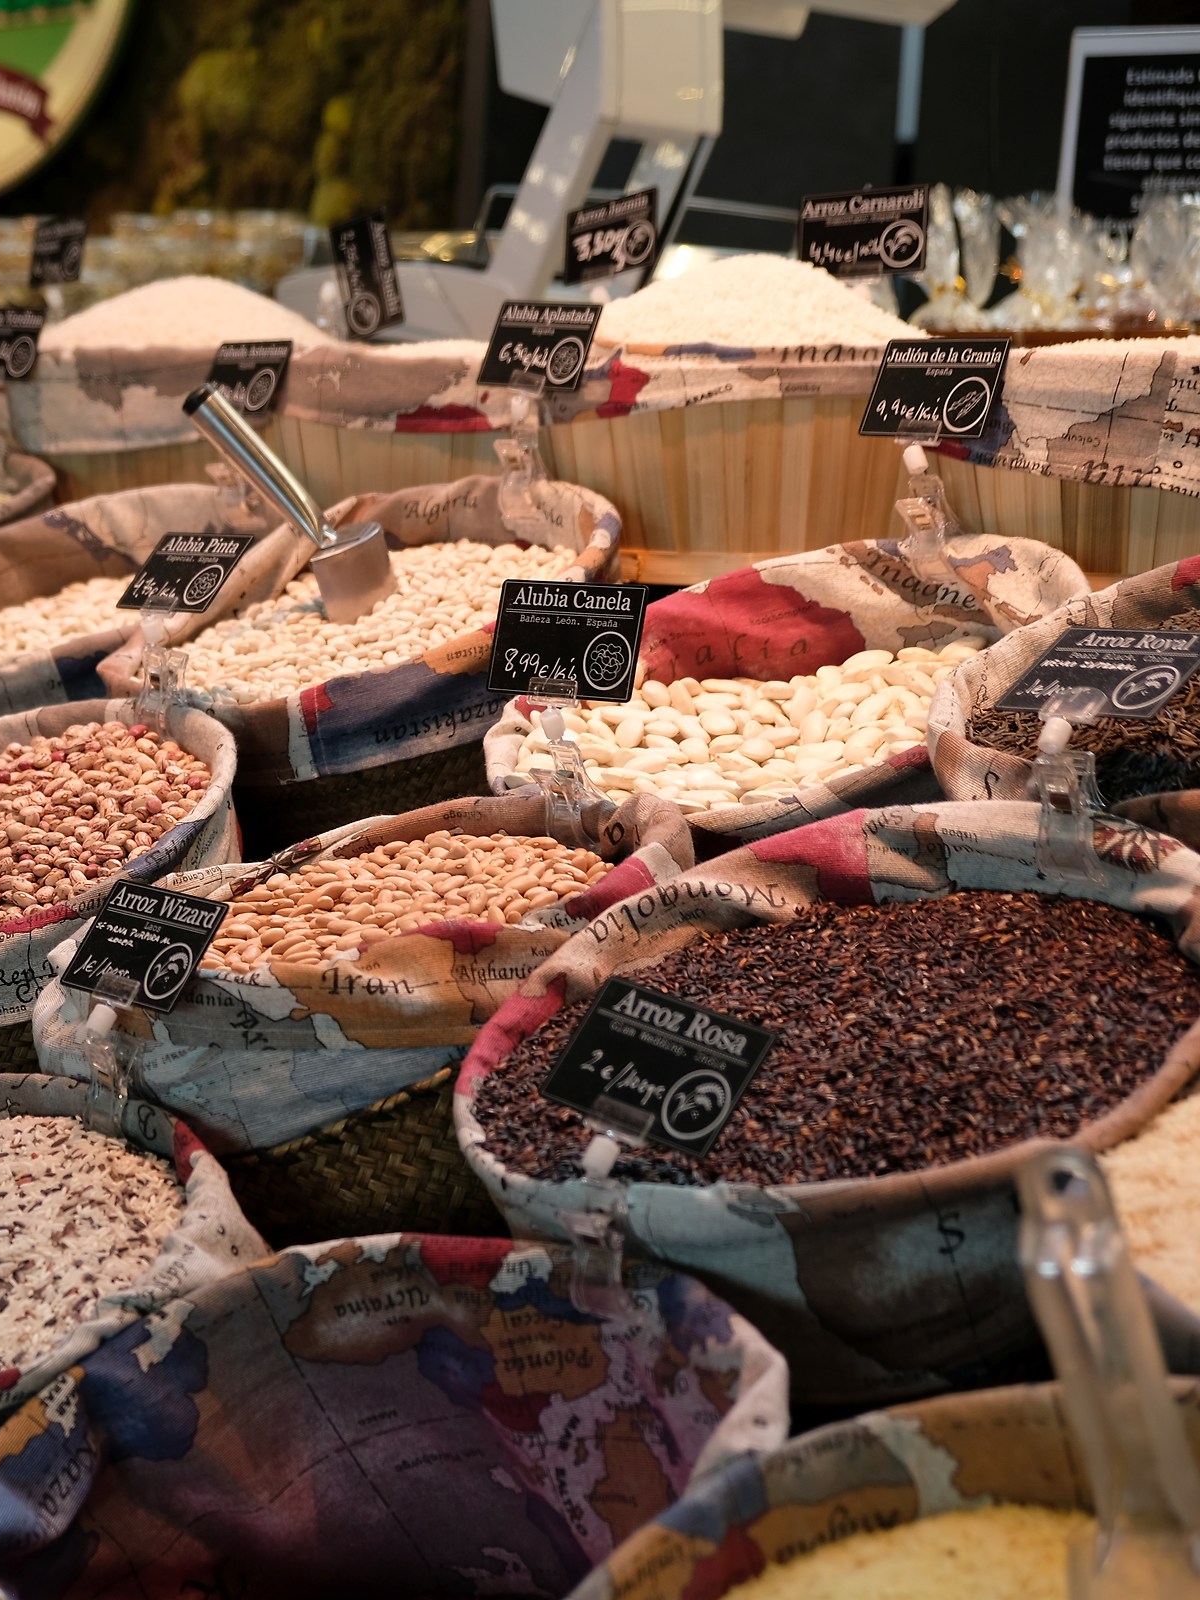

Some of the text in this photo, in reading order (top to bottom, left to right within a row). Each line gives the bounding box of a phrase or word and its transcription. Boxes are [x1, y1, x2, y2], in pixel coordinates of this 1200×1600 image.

[801, 189, 924, 219] Arroz Carnaroli
[503, 305, 595, 327] Alubia Aplastada
[887, 347, 1002, 365] Judión de la Granja
[925, 367, 953, 378] España
[161, 536, 240, 554] Alubia Pinta
[513, 586, 631, 612] Alubia Canela
[519, 614, 618, 628] Bañeza León. España
[1076, 632, 1200, 652] Arroz Royal
[110, 886, 159, 914] Arroz
[159, 895, 222, 929] Wizard
[144, 921, 162, 933] Laos
[321, 967, 414, 997] Iran
[612, 988, 748, 1056] Arroz Rosa
